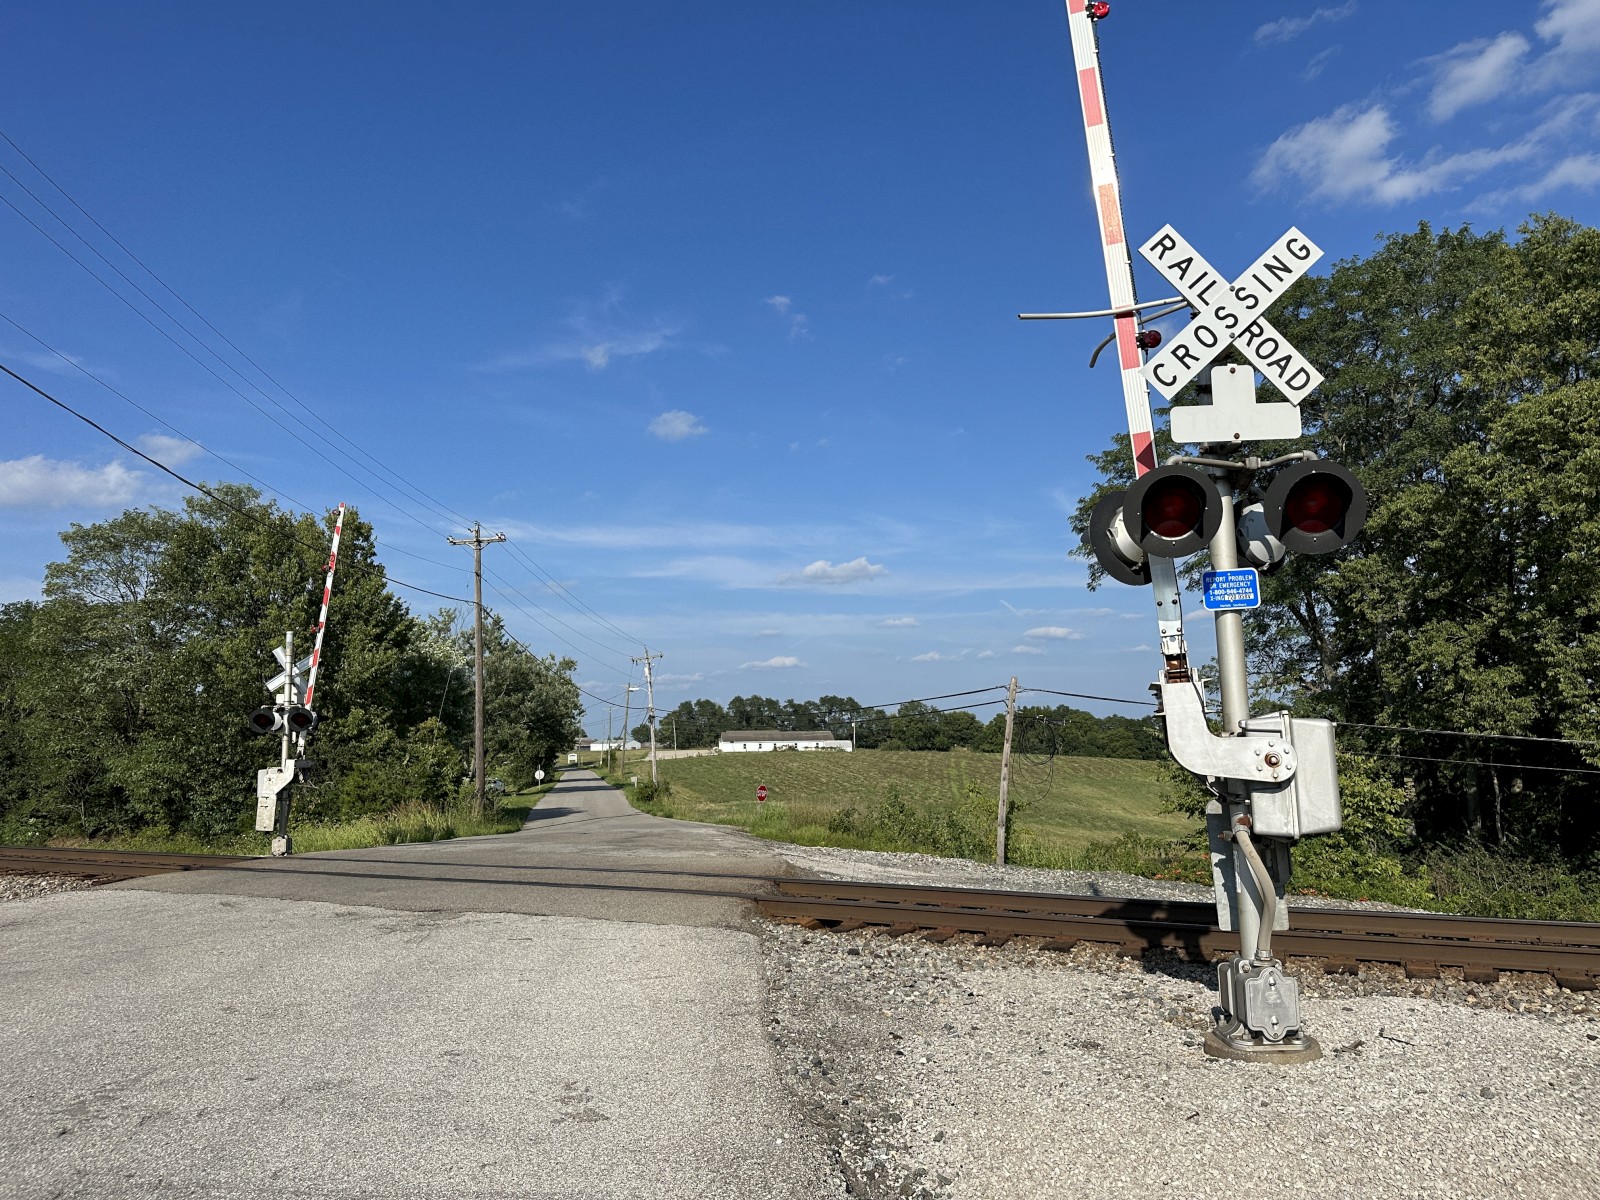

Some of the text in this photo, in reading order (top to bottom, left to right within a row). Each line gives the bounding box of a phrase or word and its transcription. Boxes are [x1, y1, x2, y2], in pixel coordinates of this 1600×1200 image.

[1149, 233, 1311, 391] RAIL ROAD
[1153, 238, 1311, 388] CROSSING
[1219, 581, 1251, 589] EMERGENCY
